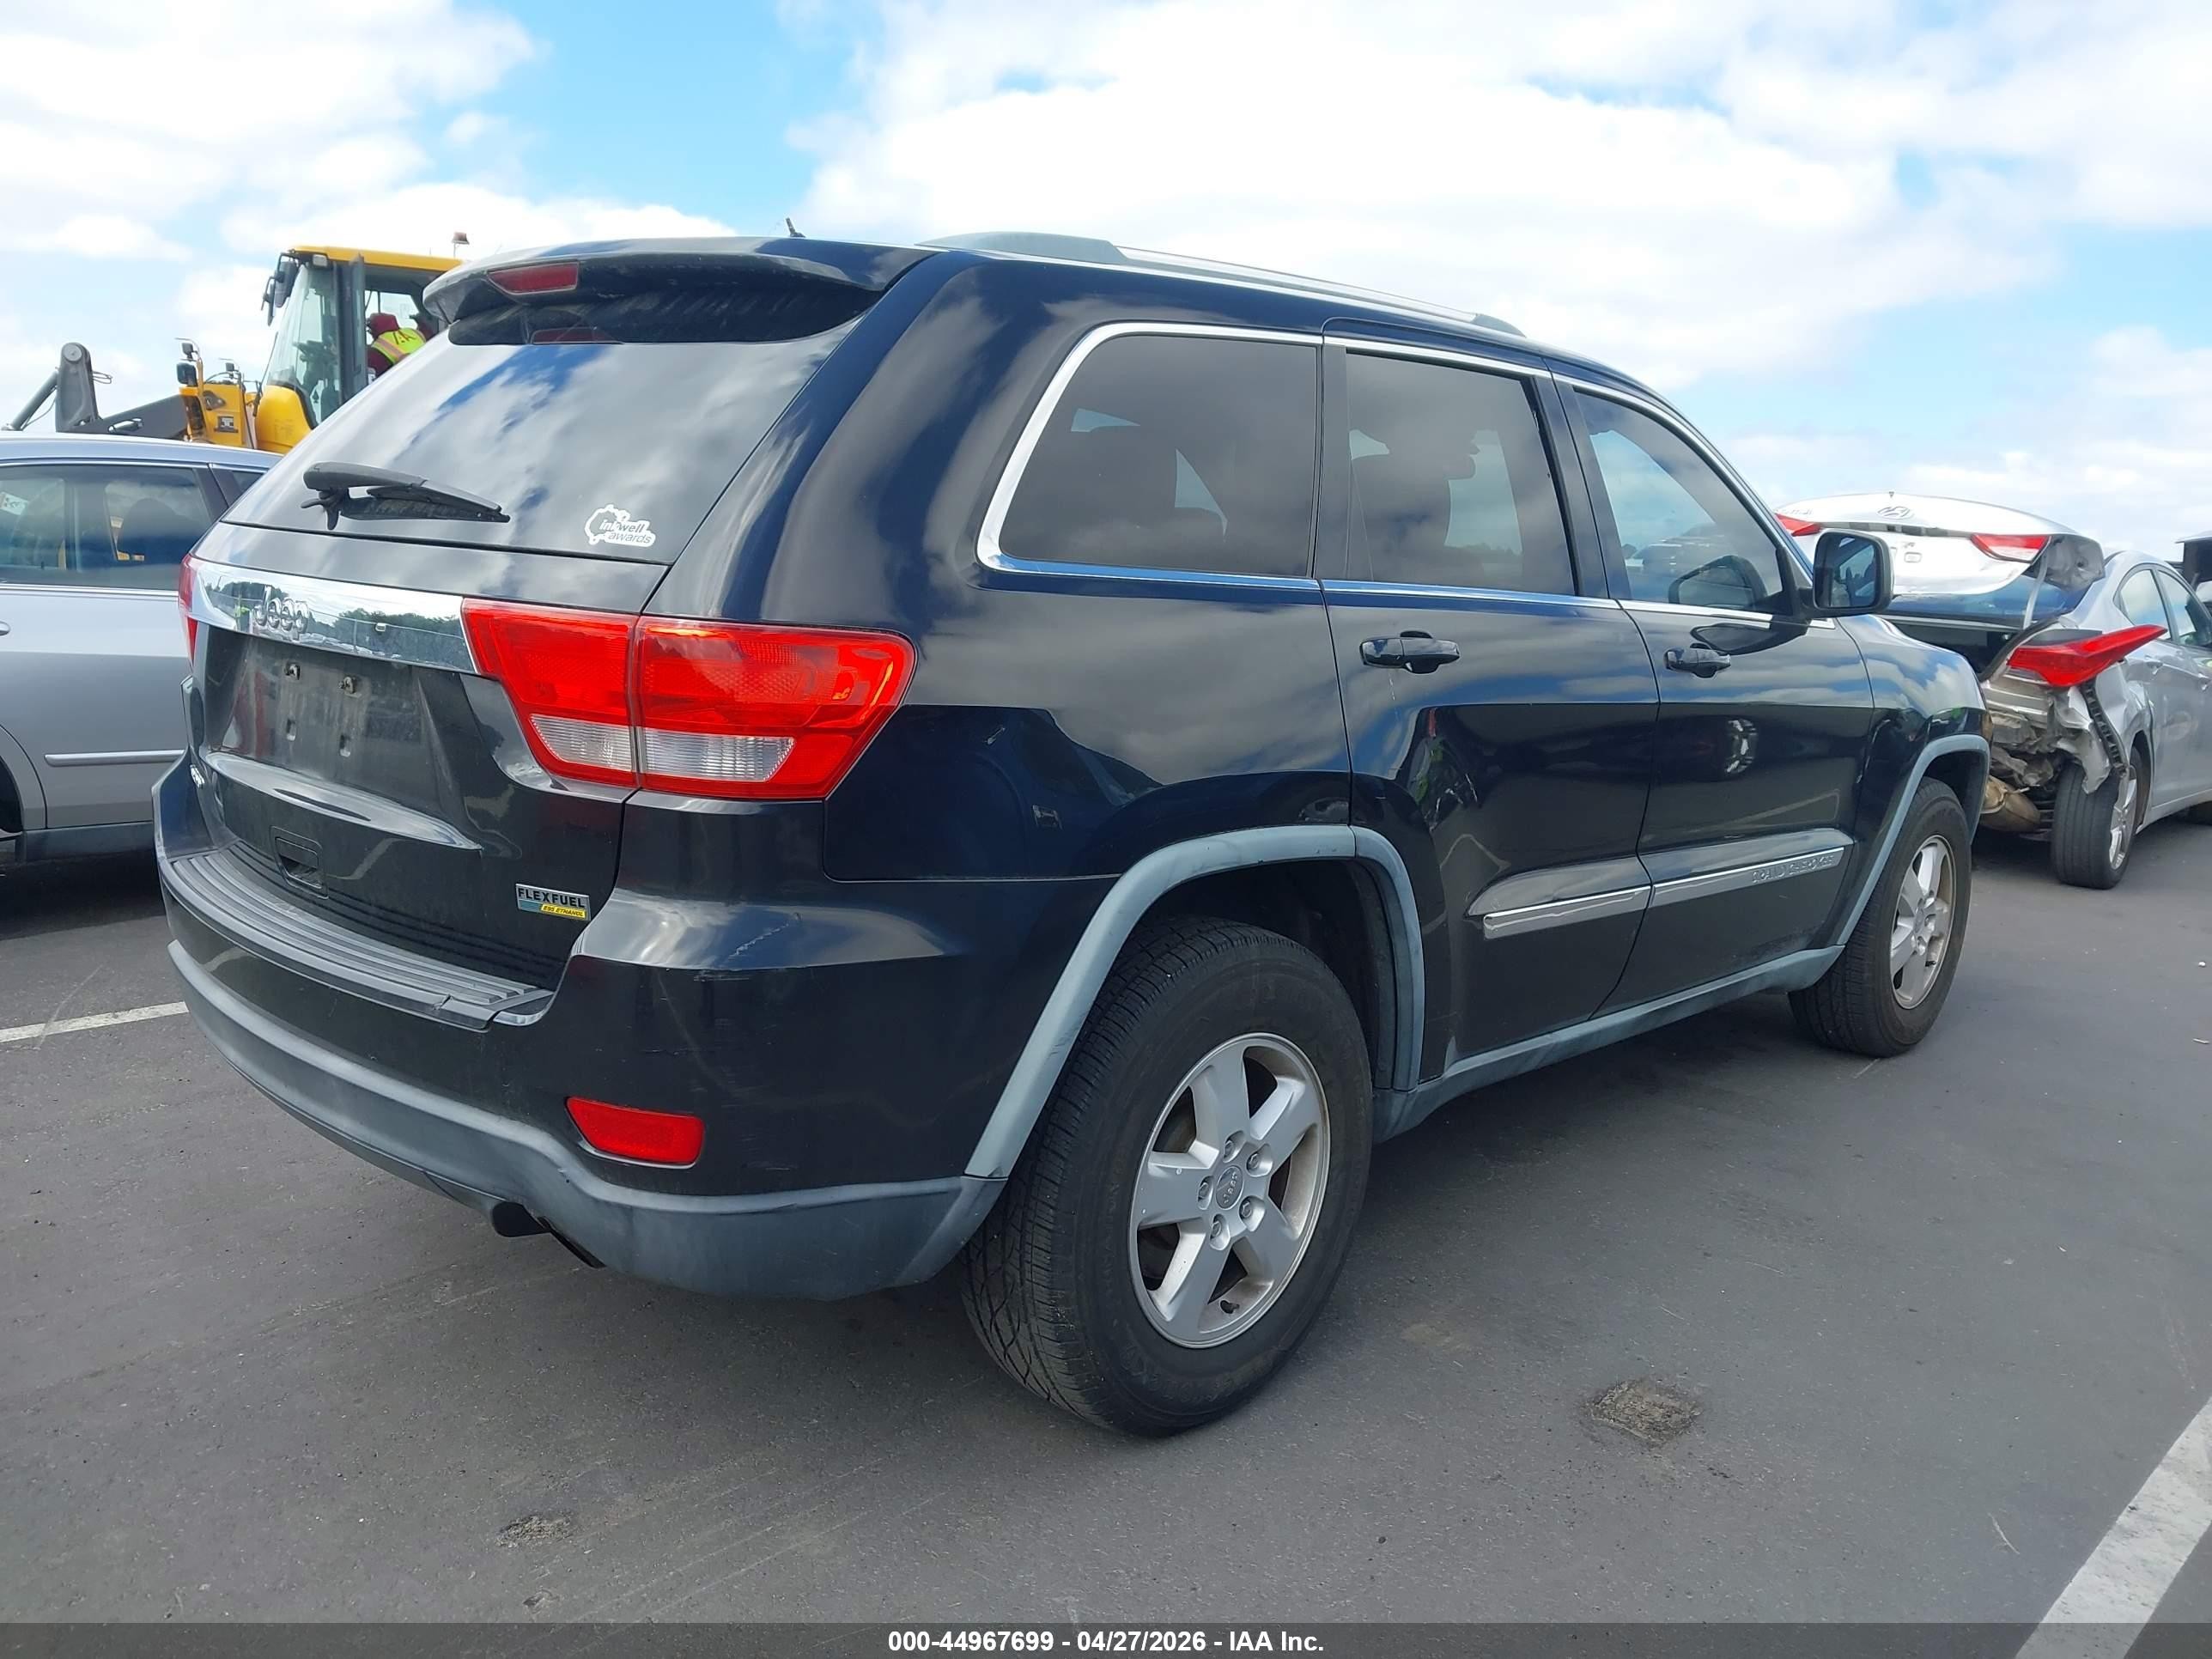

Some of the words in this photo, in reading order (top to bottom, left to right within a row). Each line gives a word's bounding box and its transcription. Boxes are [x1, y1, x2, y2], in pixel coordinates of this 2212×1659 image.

[599, 519, 646, 533] inkwell
[608, 532, 653, 544] awards
[254, 584, 309, 641] Jeep
[517, 887, 586, 908] FLEXFUEL
